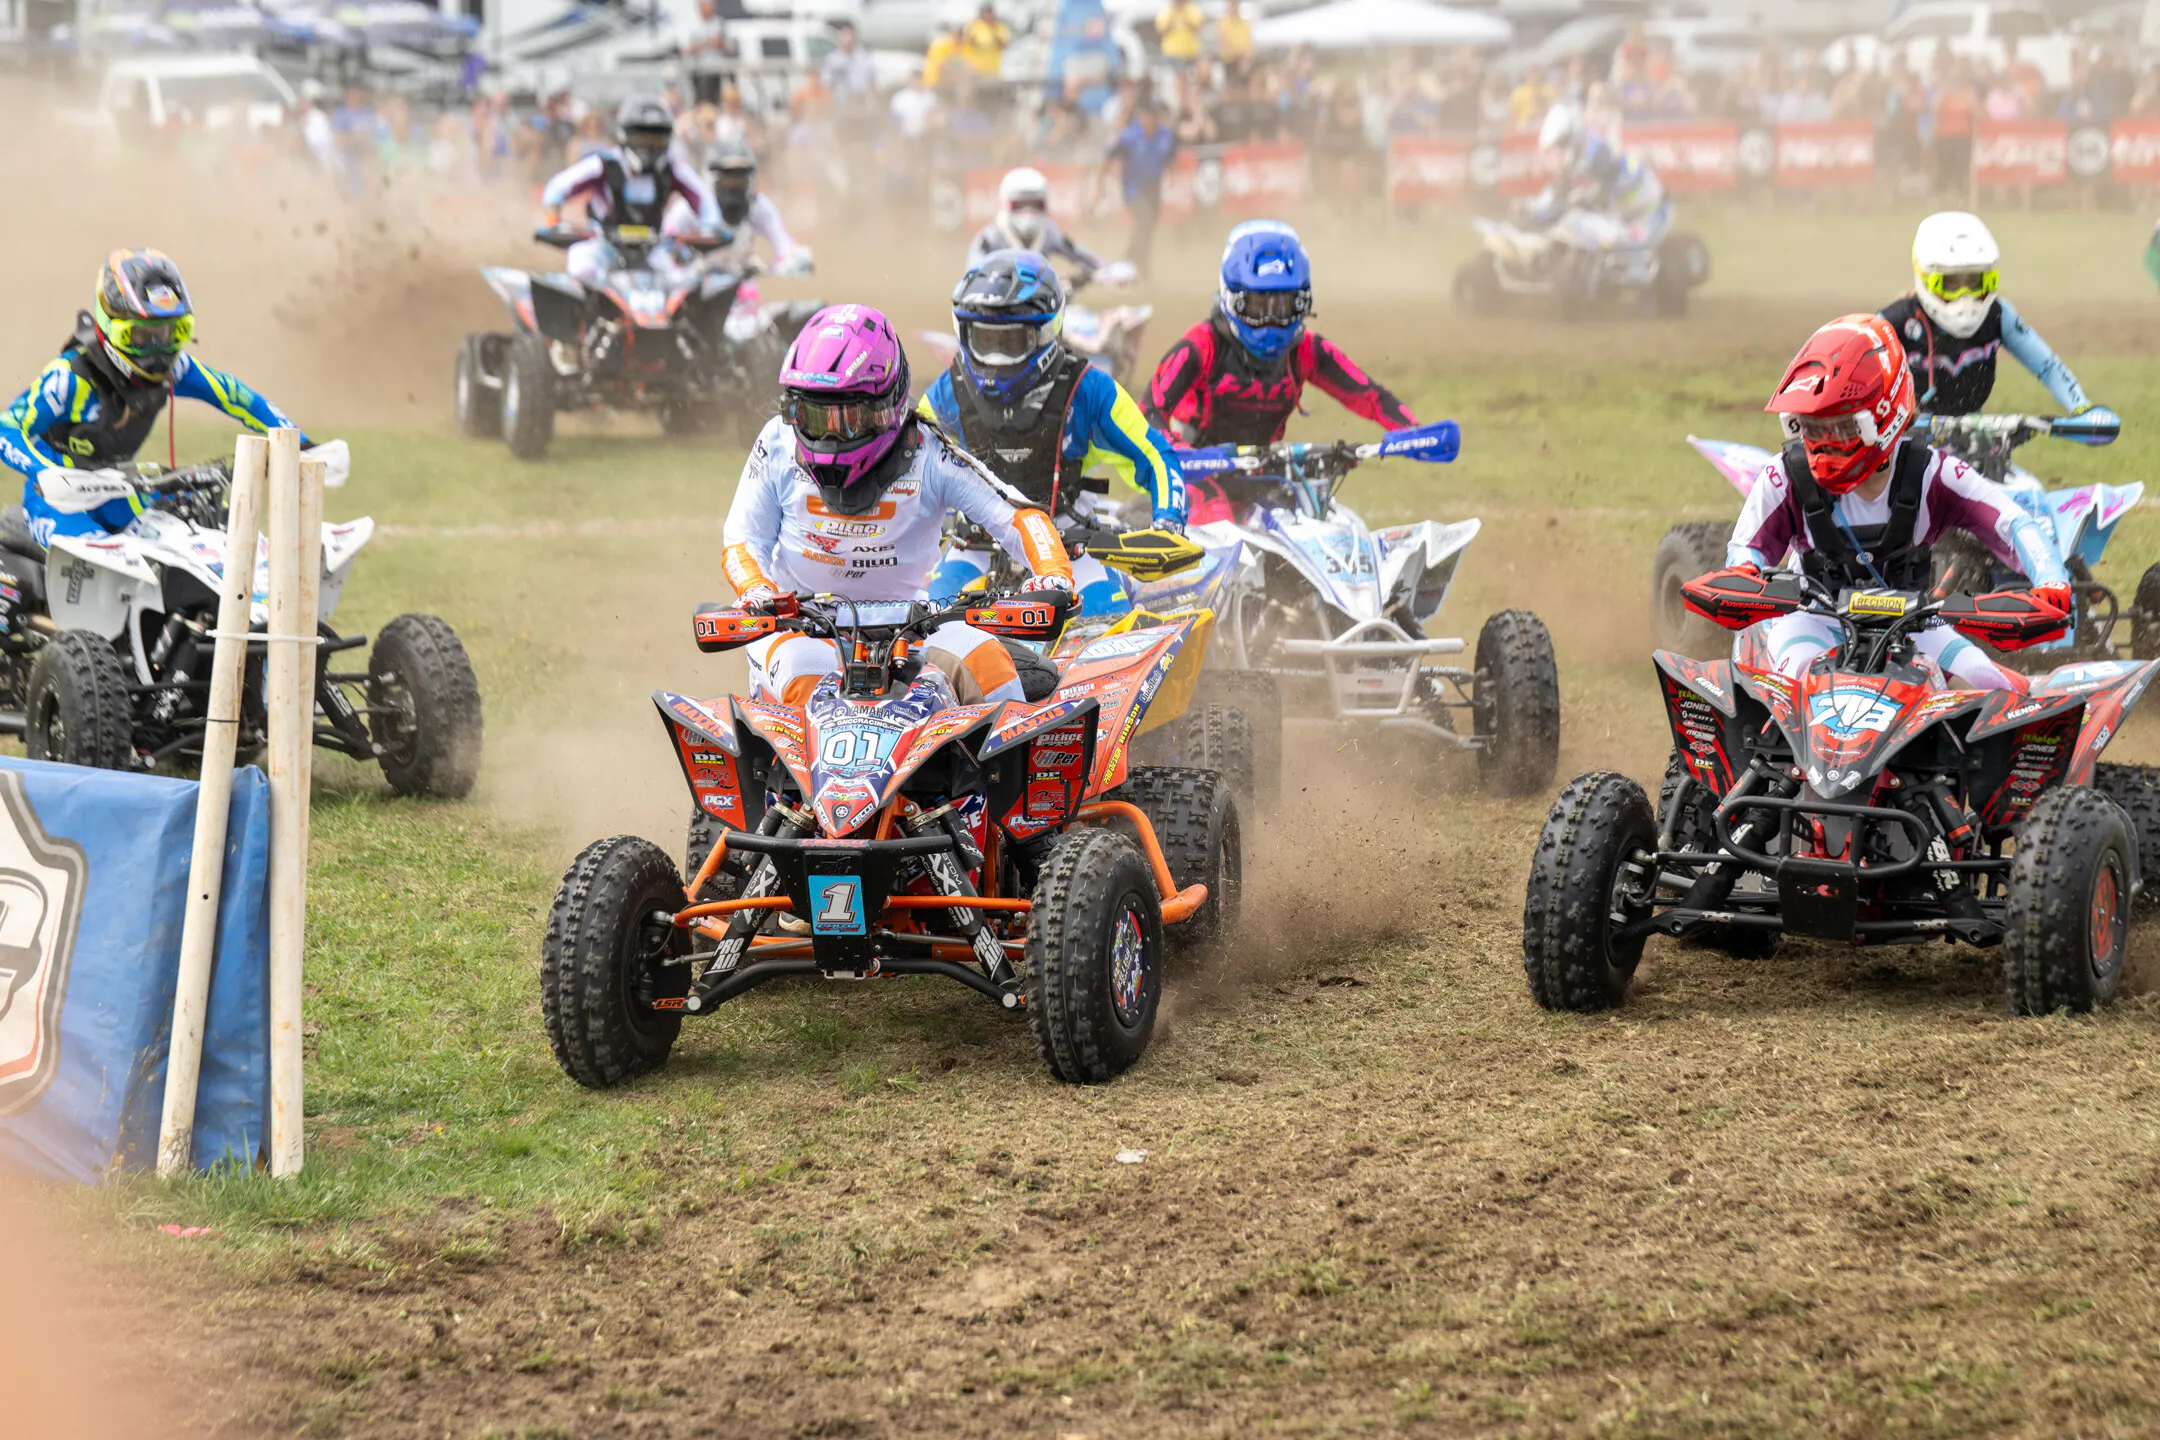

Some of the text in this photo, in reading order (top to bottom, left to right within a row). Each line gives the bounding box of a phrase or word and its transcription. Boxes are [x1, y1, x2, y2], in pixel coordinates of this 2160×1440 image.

[820, 520, 887, 535] PIERCE
[802, 548, 846, 567] MAXXIS
[852, 543, 896, 553] AXIS
[1021, 610, 1050, 626] 01
[697, 620, 719, 637] 01
[1694, 676, 1725, 697] KENDA
[847, 704, 891, 720] YAMAHA
[1680, 700, 1711, 713] JONES
[2006, 702, 2043, 720] KENDA
[671, 701, 727, 739] MAXXIS
[999, 706, 1066, 743] MAXXIS
[1118, 703, 1141, 746] HINSON
[822, 730, 883, 767] 01
[1036, 732, 1084, 747] PIERCE
[2020, 743, 2057, 753] JONES
[693, 753, 724, 761] DP
[1032, 749, 1082, 767] HiPer
[849, 802, 875, 828] CECCO
[816, 882, 857, 923] 1
[713, 937, 746, 956] PRO
[972, 926, 992, 963] PRO
[710, 952, 742, 971] AIR
[985, 938, 1005, 972] AIR
